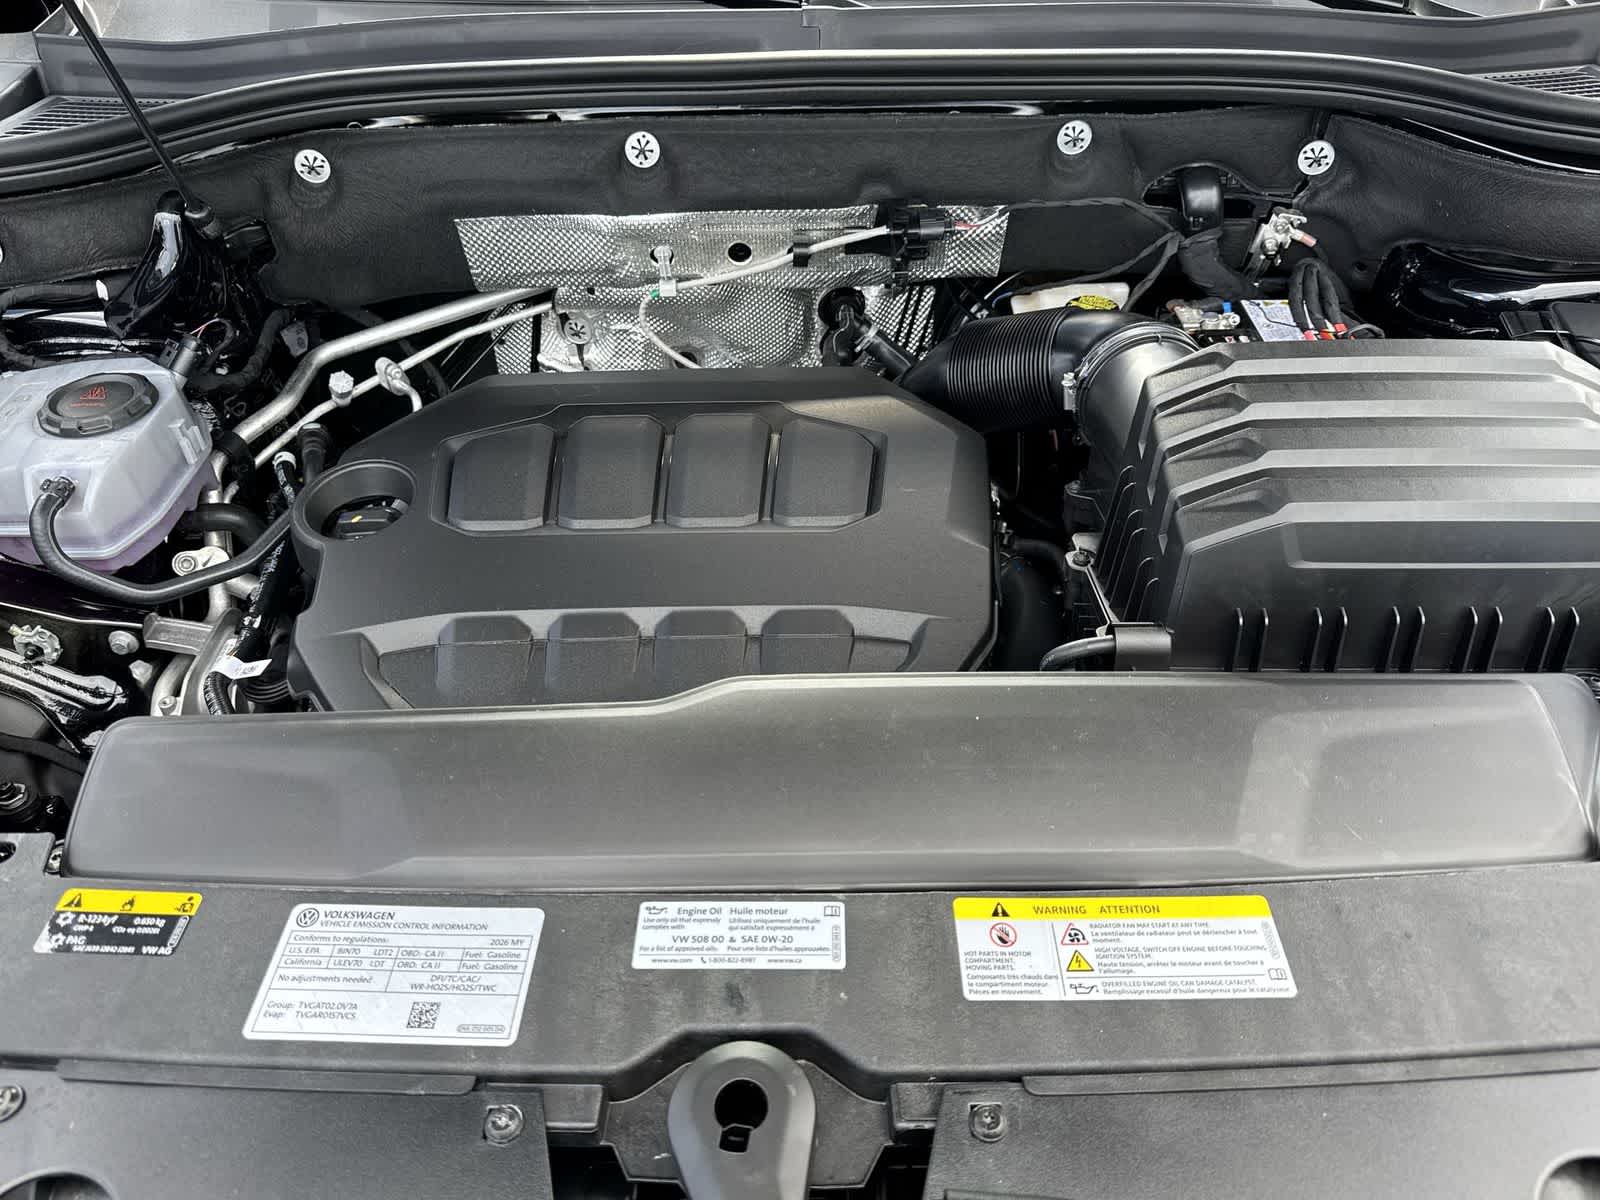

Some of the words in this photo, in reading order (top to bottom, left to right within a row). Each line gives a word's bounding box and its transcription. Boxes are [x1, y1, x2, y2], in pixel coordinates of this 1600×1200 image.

[678, 907, 707, 916] Engine
[709, 907, 722, 915] Oil
[730, 907, 753, 915] Huile
[1033, 906, 1087, 915] WARNING
[1100, 905, 1160, 914] ATTENTION
[324, 910, 395, 920] VOLKSWAGEN
[393, 922, 429, 930] CONTROL
[66, 936, 87, 945] PAG
[142, 946, 158, 954] VW
[158, 947, 173, 955] AG
[284, 958, 322, 966] California
[291, 975, 341, 983] adjustments
